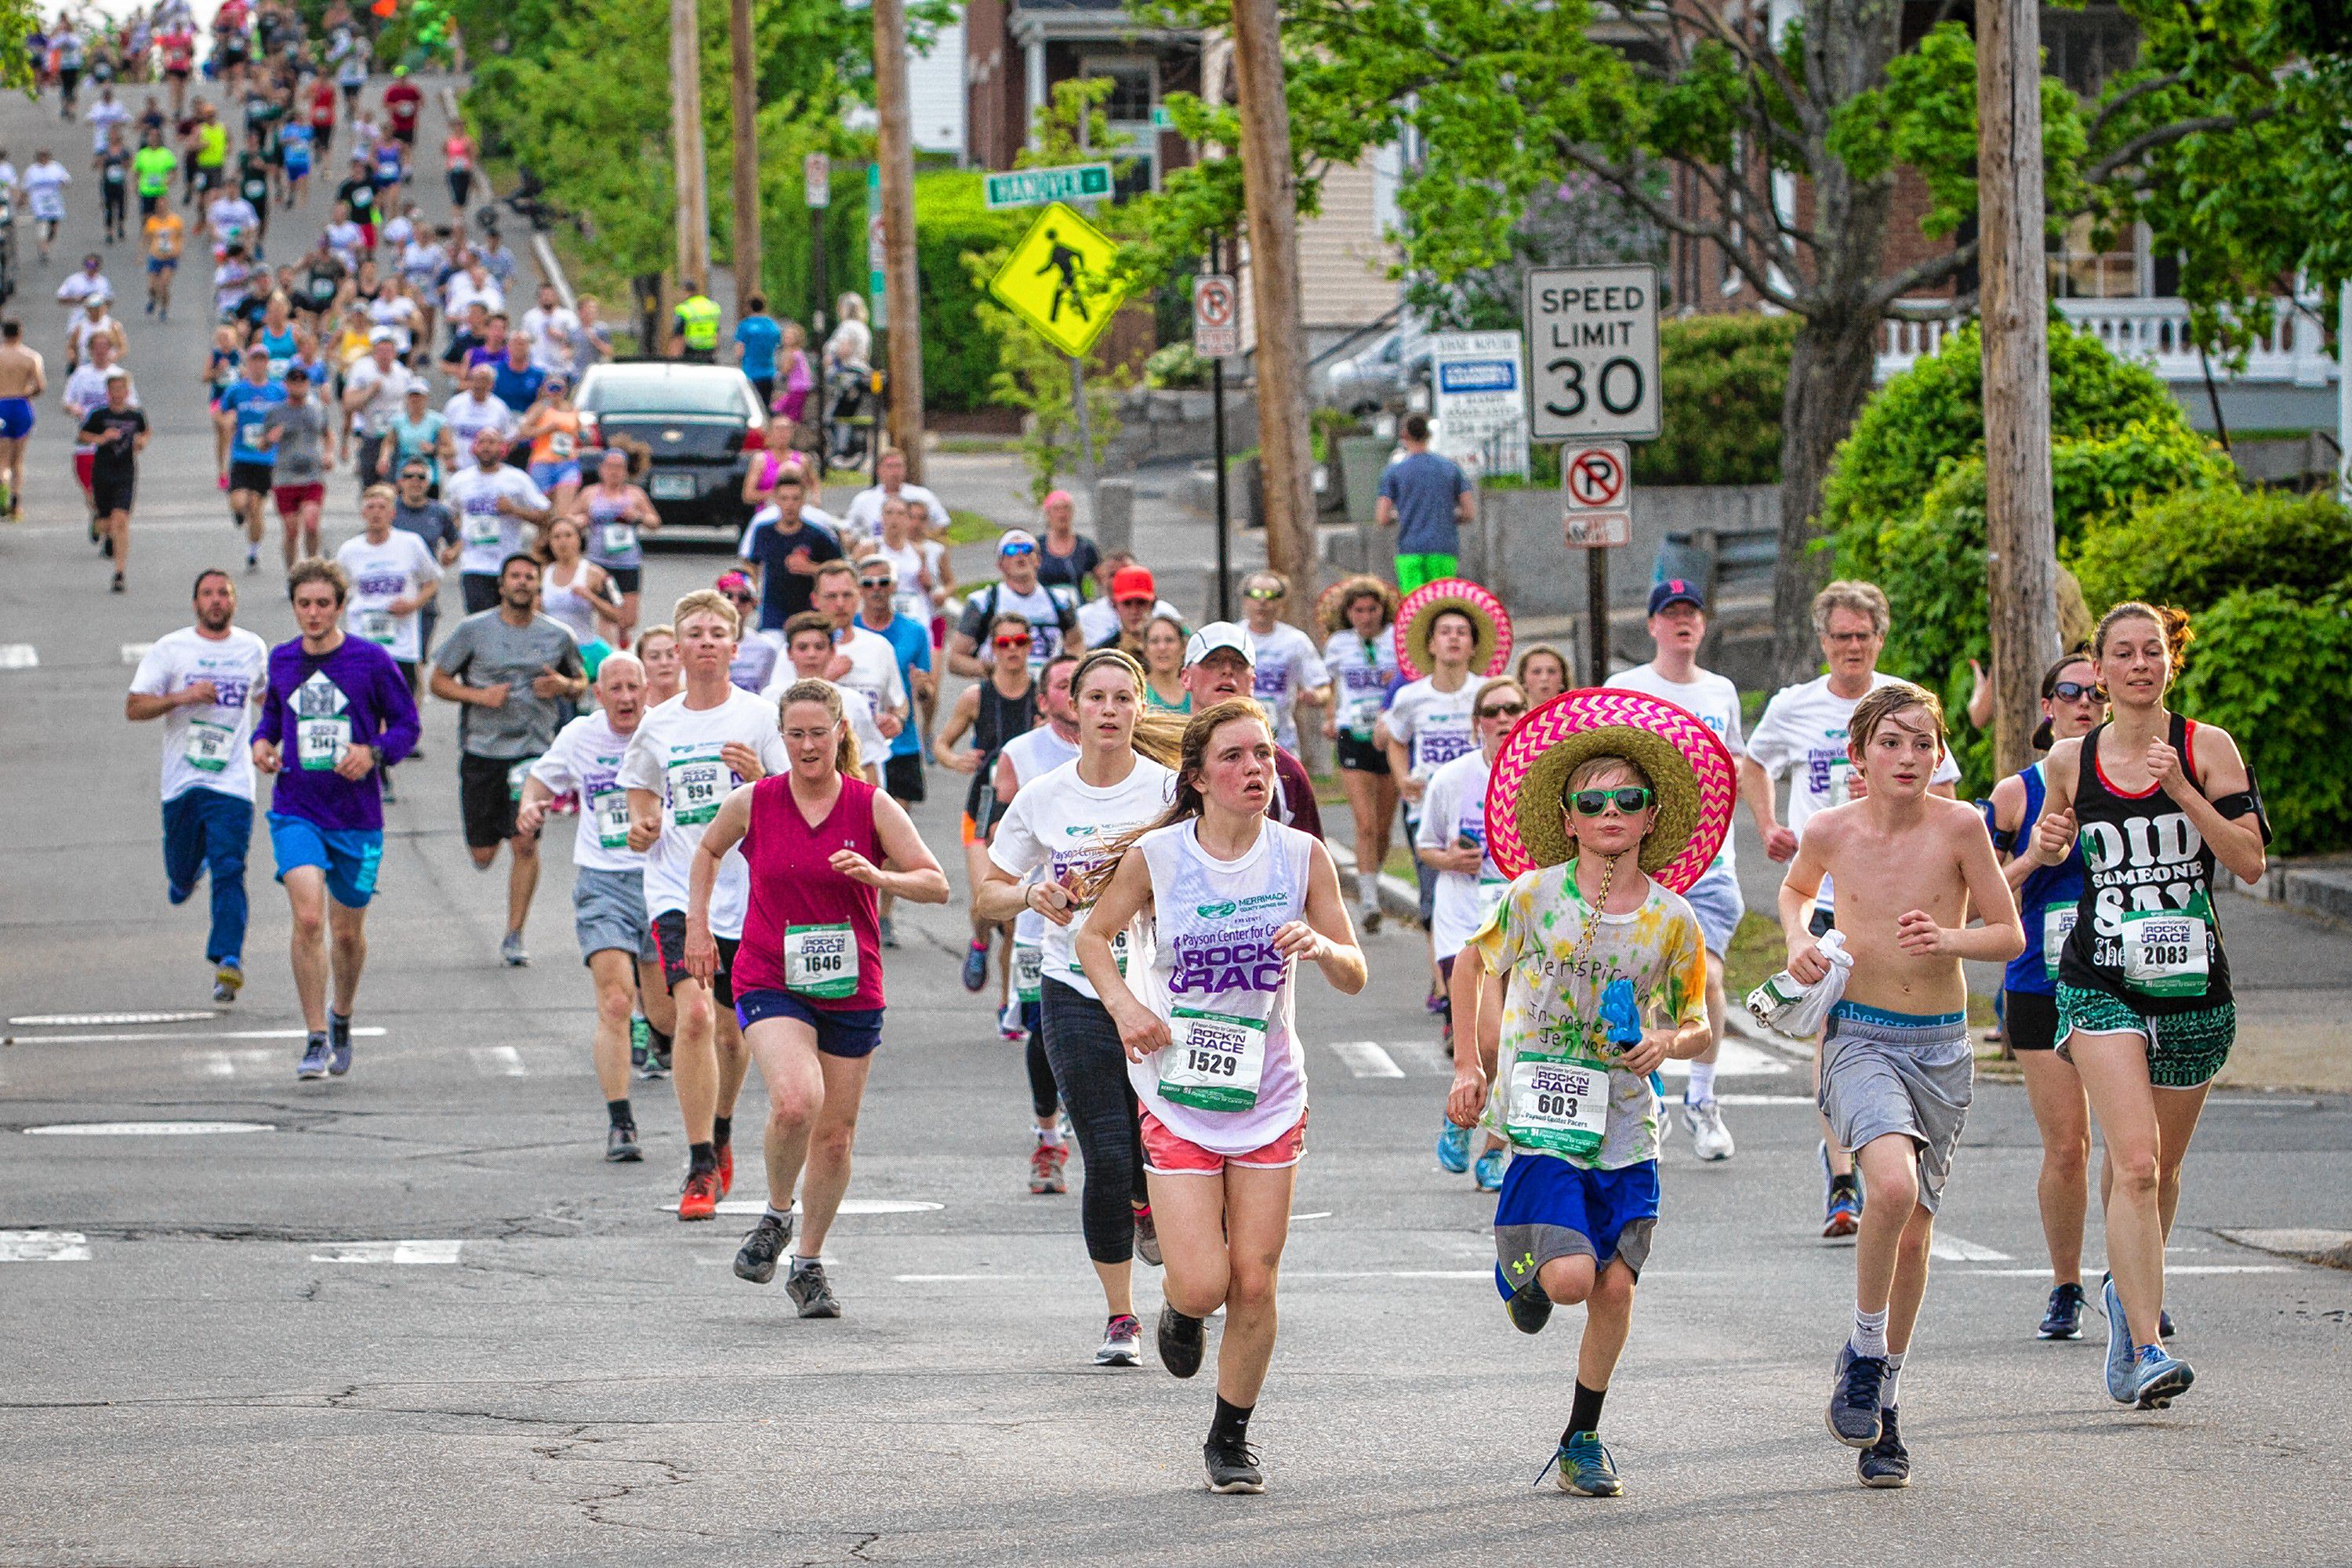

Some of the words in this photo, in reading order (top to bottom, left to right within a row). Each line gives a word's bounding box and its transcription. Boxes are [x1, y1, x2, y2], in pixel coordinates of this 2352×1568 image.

[1541, 285, 1645, 314] SPEED
[1552, 320, 1635, 347] LIMIT
[1544, 356, 1646, 417] 30
[688, 784, 713, 799] 894
[2080, 812, 2201, 873] DID
[2092, 860, 2204, 888] SOMEONE
[1239, 892, 1287, 906] MERRIMACK
[1182, 933, 1216, 948] Payson
[1218, 929, 1249, 942] Center
[1250, 926, 1263, 938] for
[2146, 933, 2190, 943] RACE
[805, 945, 845, 953] RACE
[2143, 946, 2188, 964] 2083
[804, 955, 841, 973] 1646
[1528, 1001, 1547, 1022] In
[1192, 1028, 1246, 1043] ROCK'N
[1539, 1027, 1574, 1048] Jen
[1192, 1036, 1245, 1054] RACE
[1188, 1050, 1237, 1076] 1529
[1537, 1071, 1589, 1085] ROCK'N
[1537, 1080, 1588, 1097] RACE
[1537, 1094, 1578, 1118] 603
[1568, 1119, 1588, 1127] Pacers
